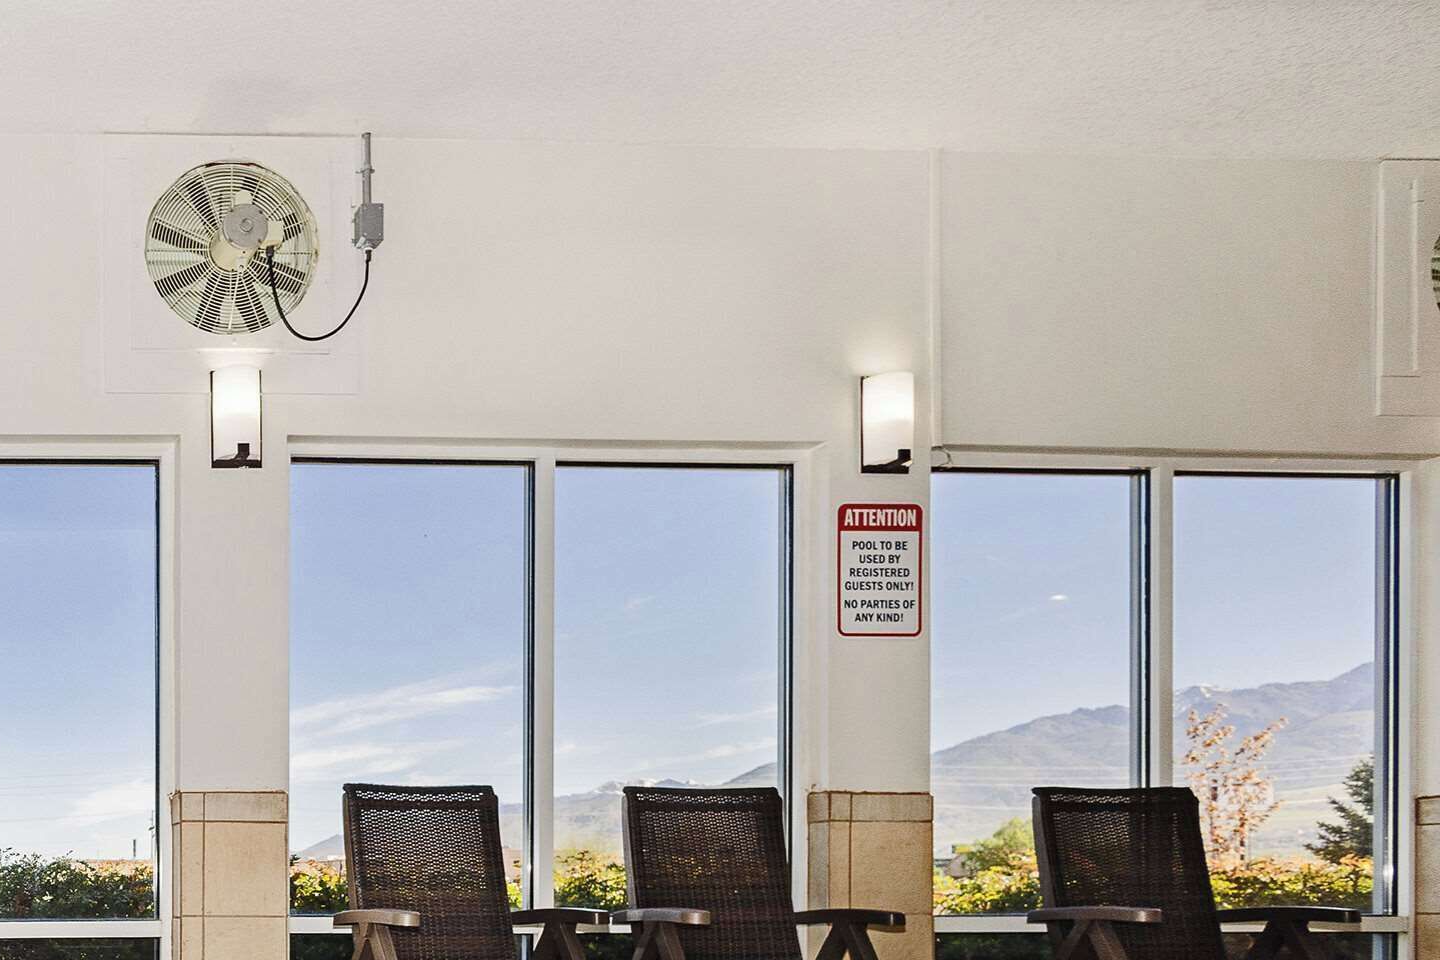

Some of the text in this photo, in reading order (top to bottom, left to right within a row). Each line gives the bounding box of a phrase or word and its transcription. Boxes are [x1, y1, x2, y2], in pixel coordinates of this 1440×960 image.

[844, 509, 917, 527] ATTENTION
[852, 541, 908, 550] POOL TO BE
[859, 554, 901, 564] USED BY
[849, 568, 910, 577] REGISTERED
[845, 581, 914, 591] GUESTS ONLY!
[844, 600, 916, 609] NO PARTIES OF
[855, 613, 904, 622] ANY KIND!
